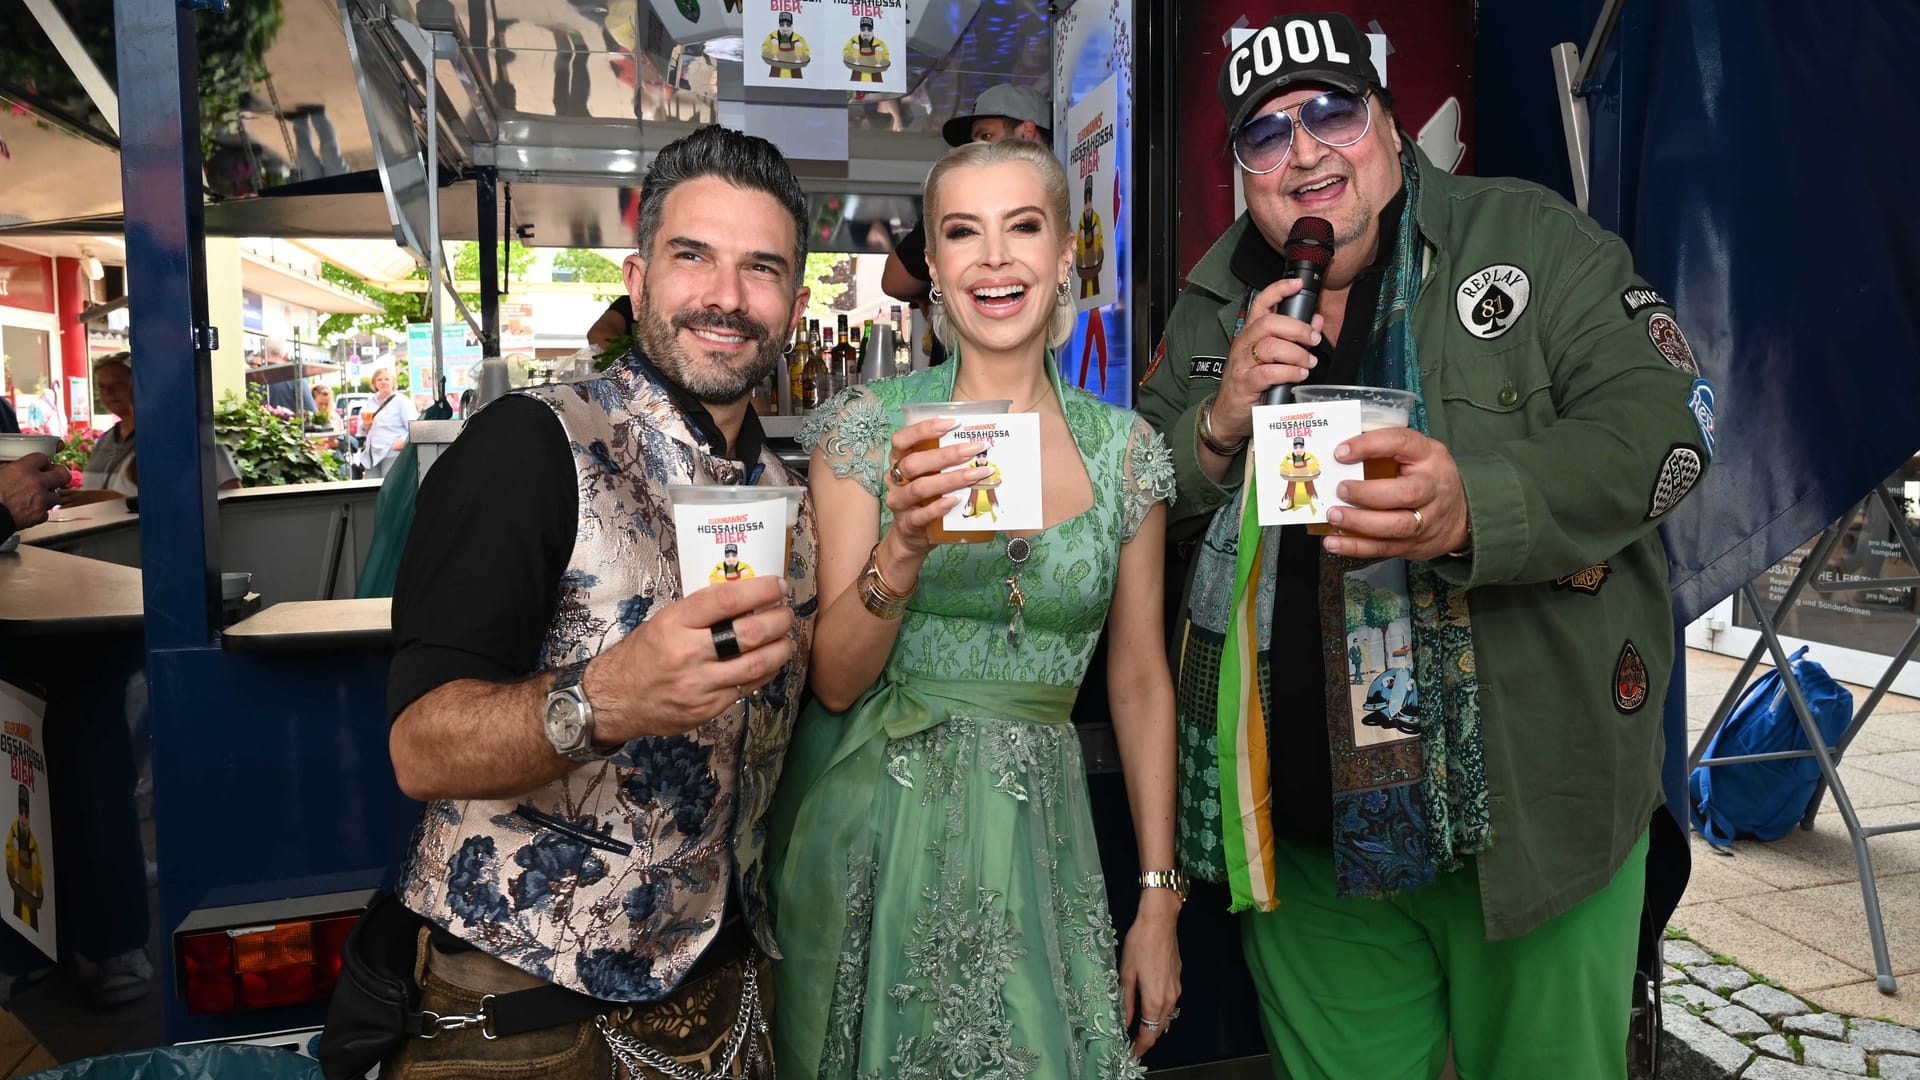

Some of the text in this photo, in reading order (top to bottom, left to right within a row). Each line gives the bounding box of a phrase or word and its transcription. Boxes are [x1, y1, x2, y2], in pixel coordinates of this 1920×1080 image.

[770, 0, 802, 14] BIER
[851, 5, 882, 18] BIER
[1229, 19, 1350, 96] COOL
[1070, 123, 1114, 166] HOSSAHOSSA
[1080, 149, 1099, 180] BIER
[1462, 269, 1523, 298] REPLAY
[1482, 294, 1505, 318] 81
[1269, 419, 1329, 430] HOSSAHOSSA
[1285, 427, 1312, 438] BIER
[954, 430, 1010, 439] HOSSAHOSSA
[697, 521, 764, 534] HOSSAHOSSA
[715, 532, 746, 544] BIER
[0, 733, 46, 777] OSSAHOSSA
[11, 754, 36, 793] BIER
